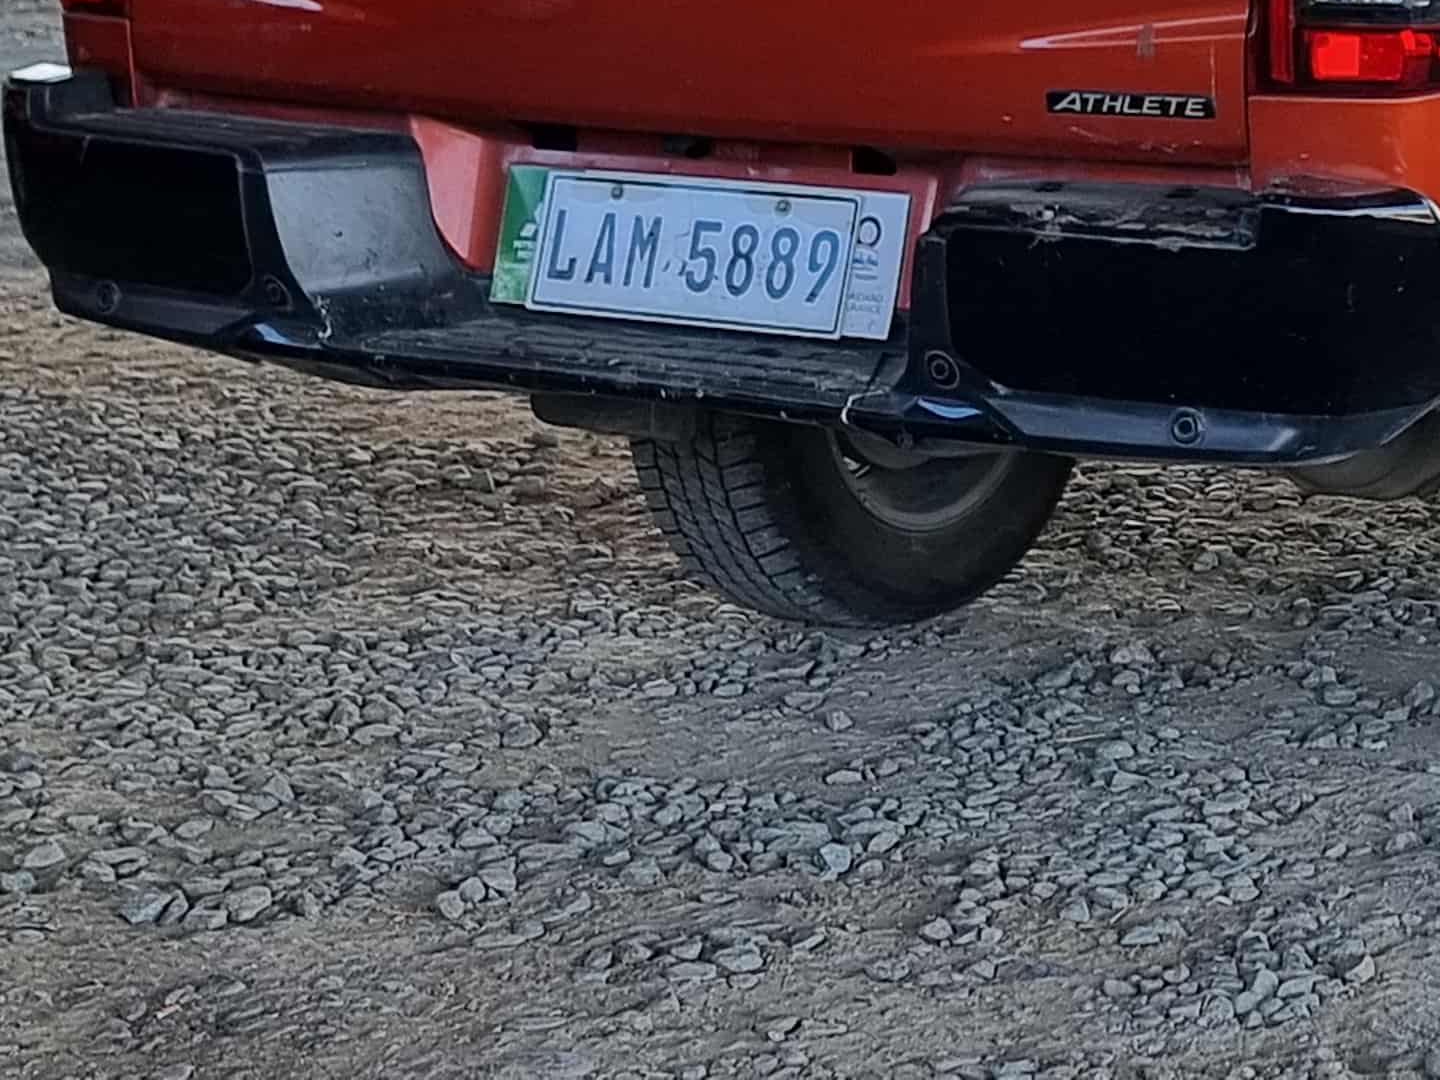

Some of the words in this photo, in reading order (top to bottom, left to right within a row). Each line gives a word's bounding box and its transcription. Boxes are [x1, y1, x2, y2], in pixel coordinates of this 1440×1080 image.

[1053, 91, 1208, 118] ATHLETE
[546, 209, 663, 290] LAM
[684, 219, 841, 304] 5889
